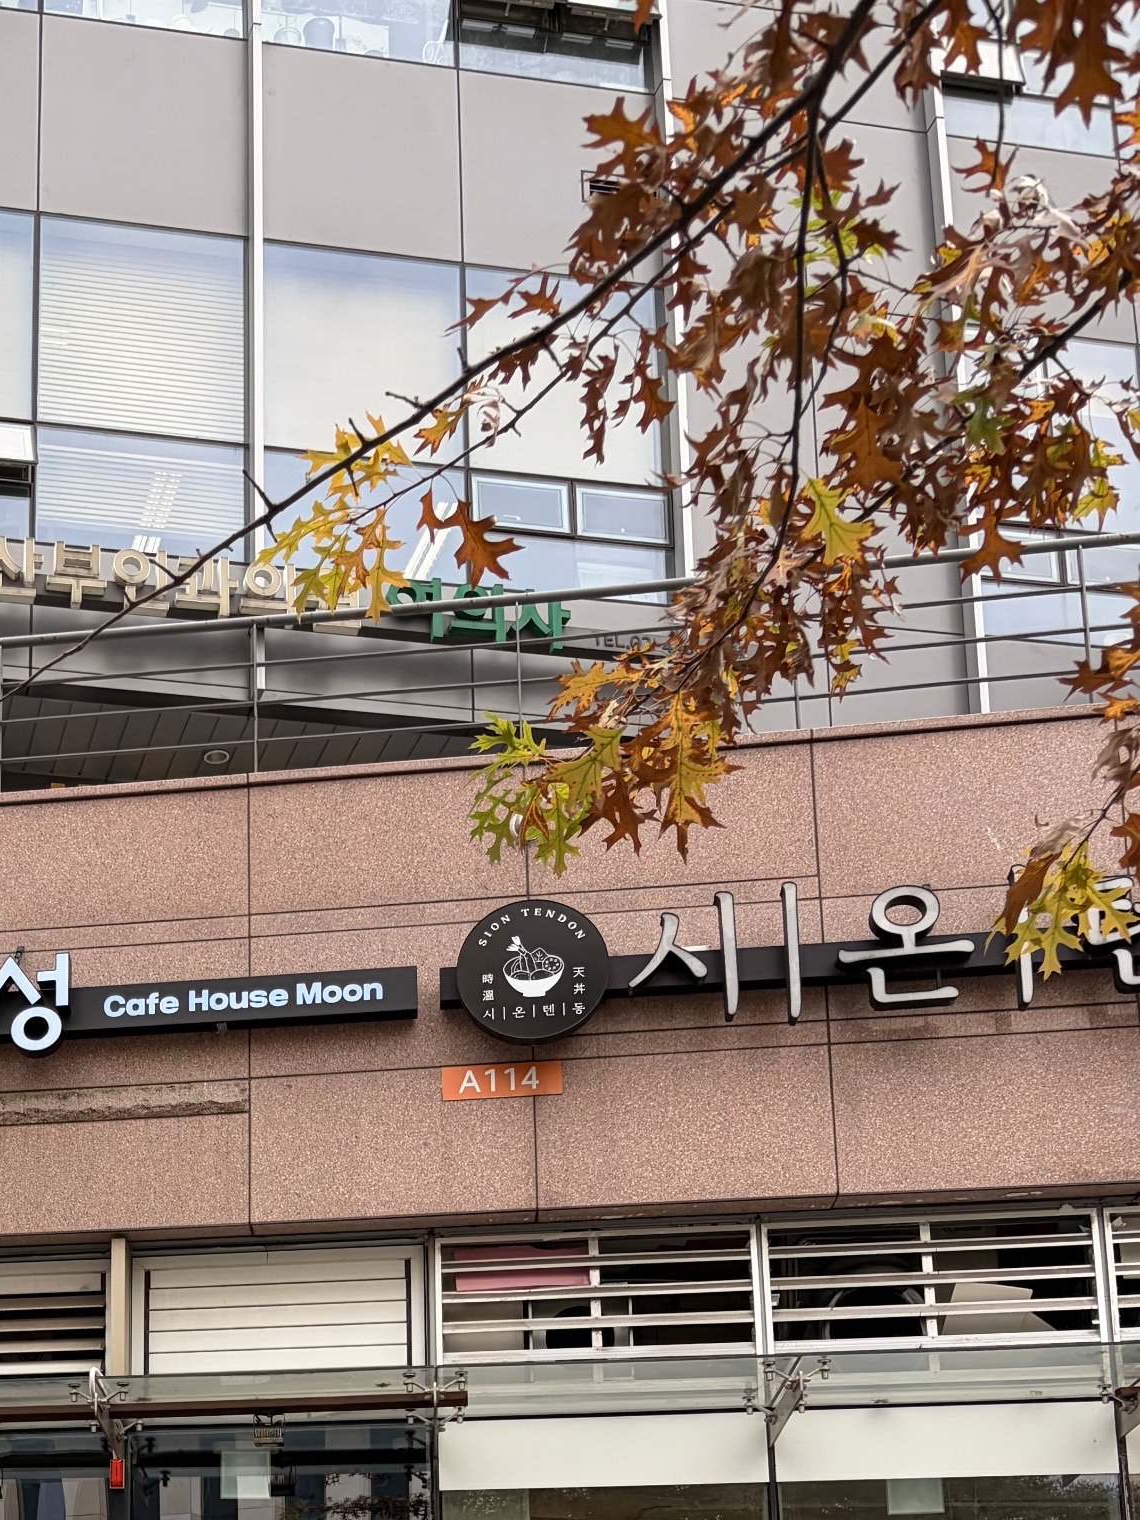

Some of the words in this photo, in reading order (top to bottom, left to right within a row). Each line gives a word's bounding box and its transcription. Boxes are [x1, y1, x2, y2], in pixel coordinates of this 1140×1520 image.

[478, 914, 511, 947] SION
[520, 907, 586, 939] TENDON
[104, 993, 179, 1018] Cafe
[188, 986, 288, 1013] House
[296, 979, 384, 1006] Moon
[459, 1066, 540, 1093] A114
